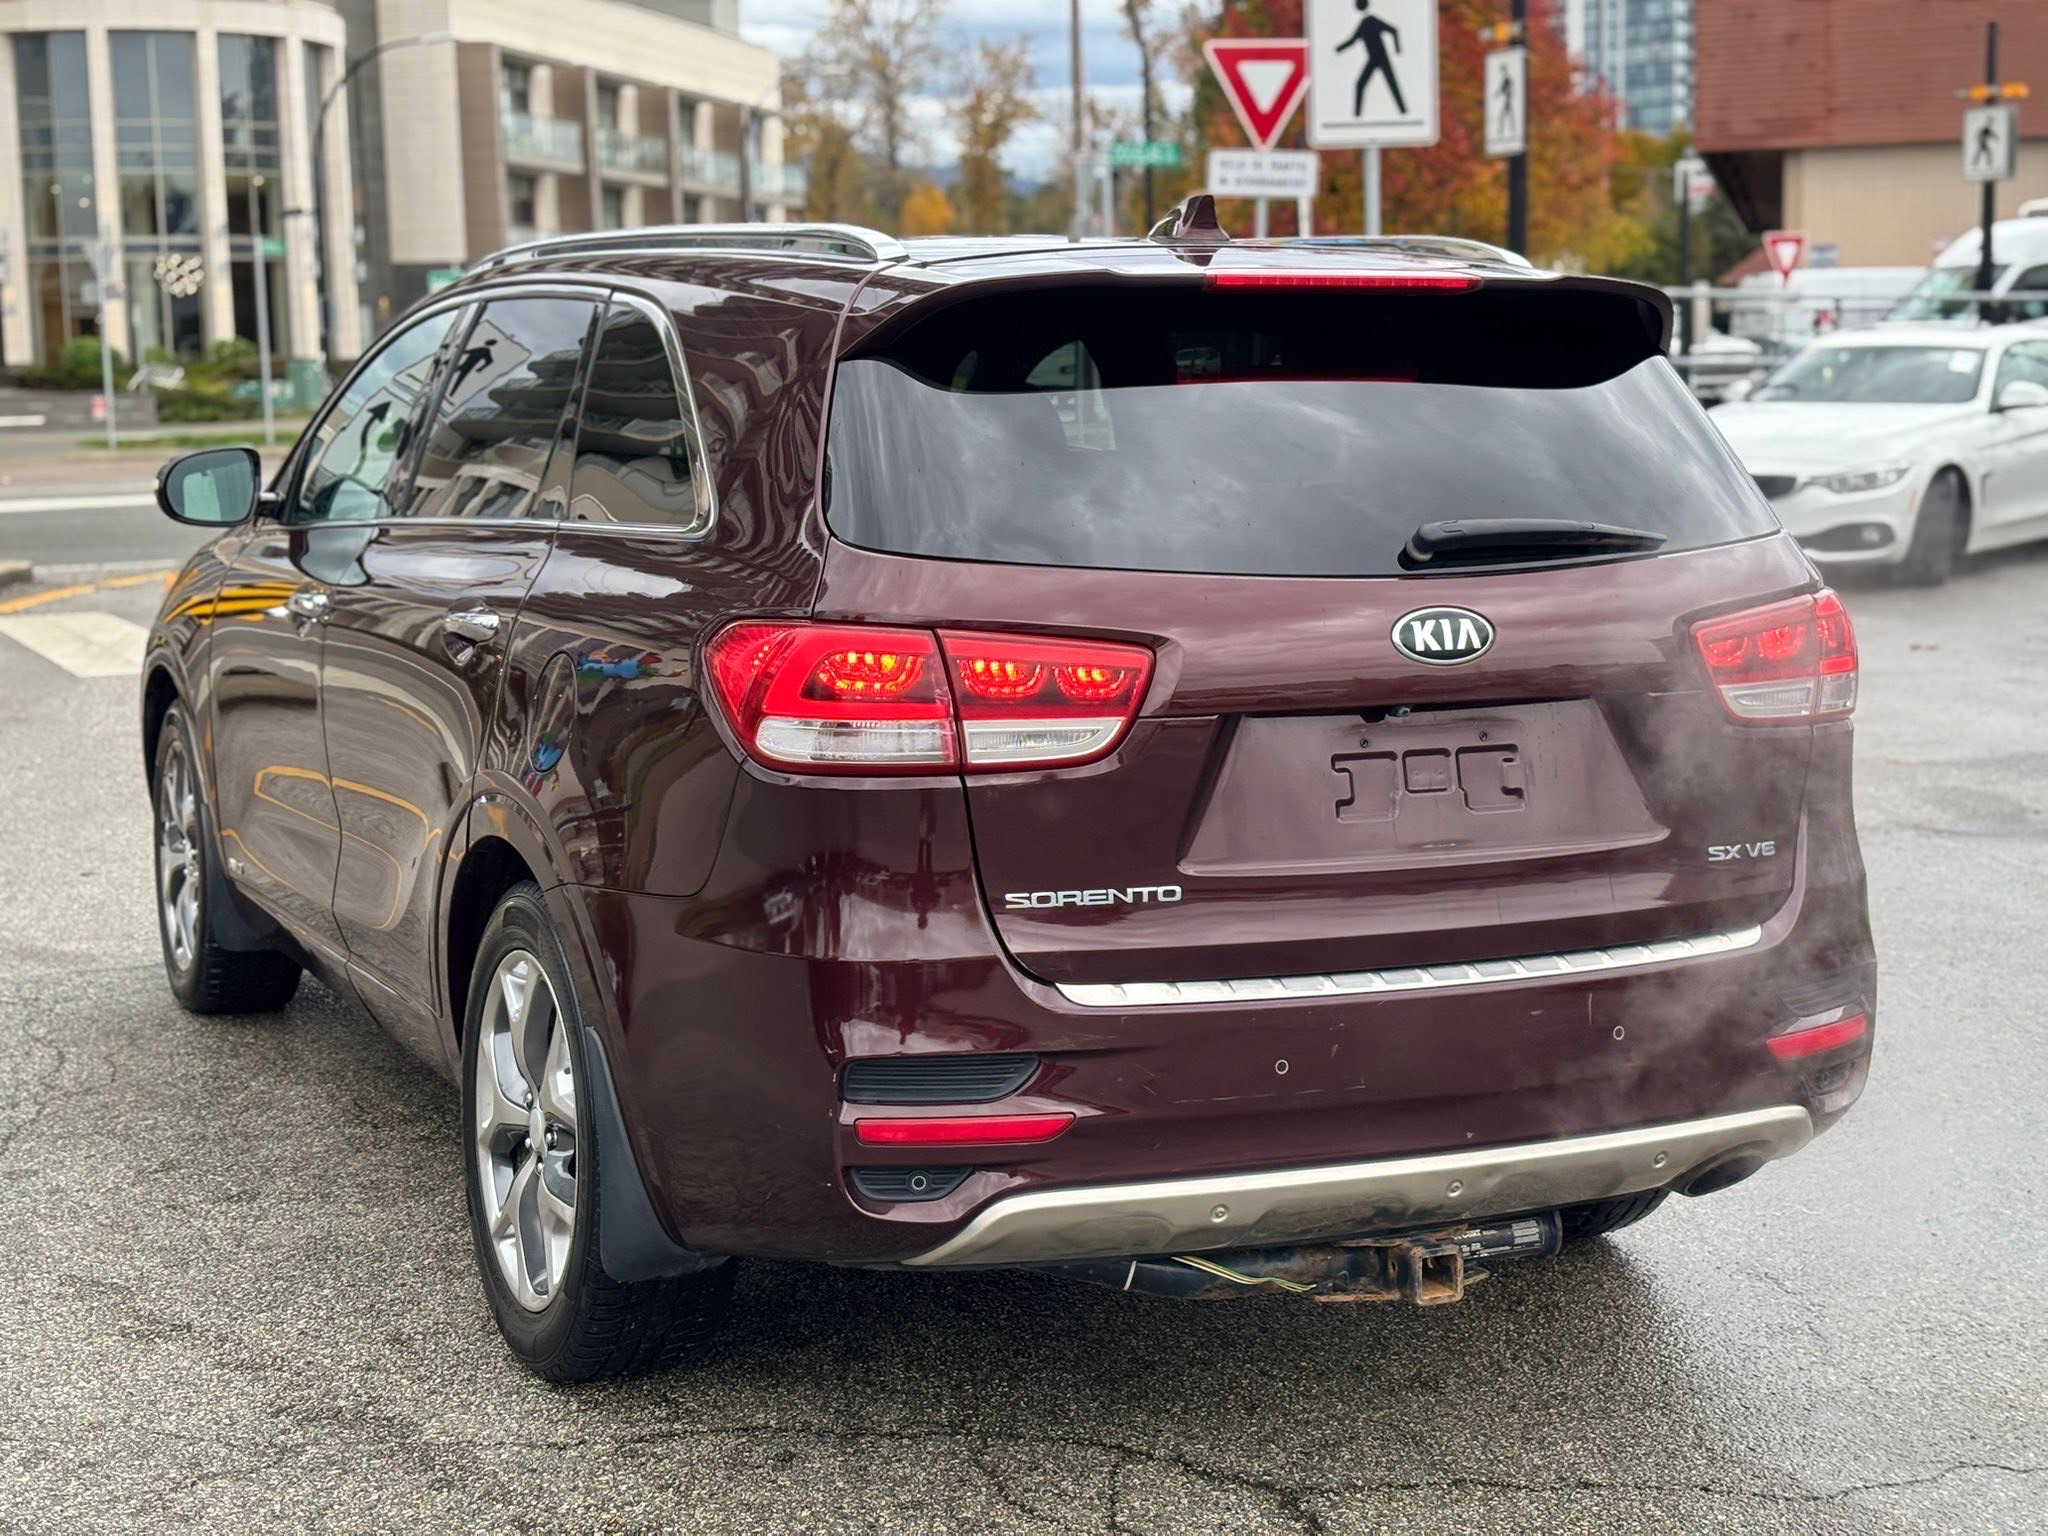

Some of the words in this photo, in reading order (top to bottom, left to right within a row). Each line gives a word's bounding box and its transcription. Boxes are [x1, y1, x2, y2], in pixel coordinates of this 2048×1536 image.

[1410, 618, 1482, 651] KIA
[1708, 844, 1741, 862] SX
[1745, 840, 1776, 858] V6
[1004, 885, 1182, 909] SORENTO
